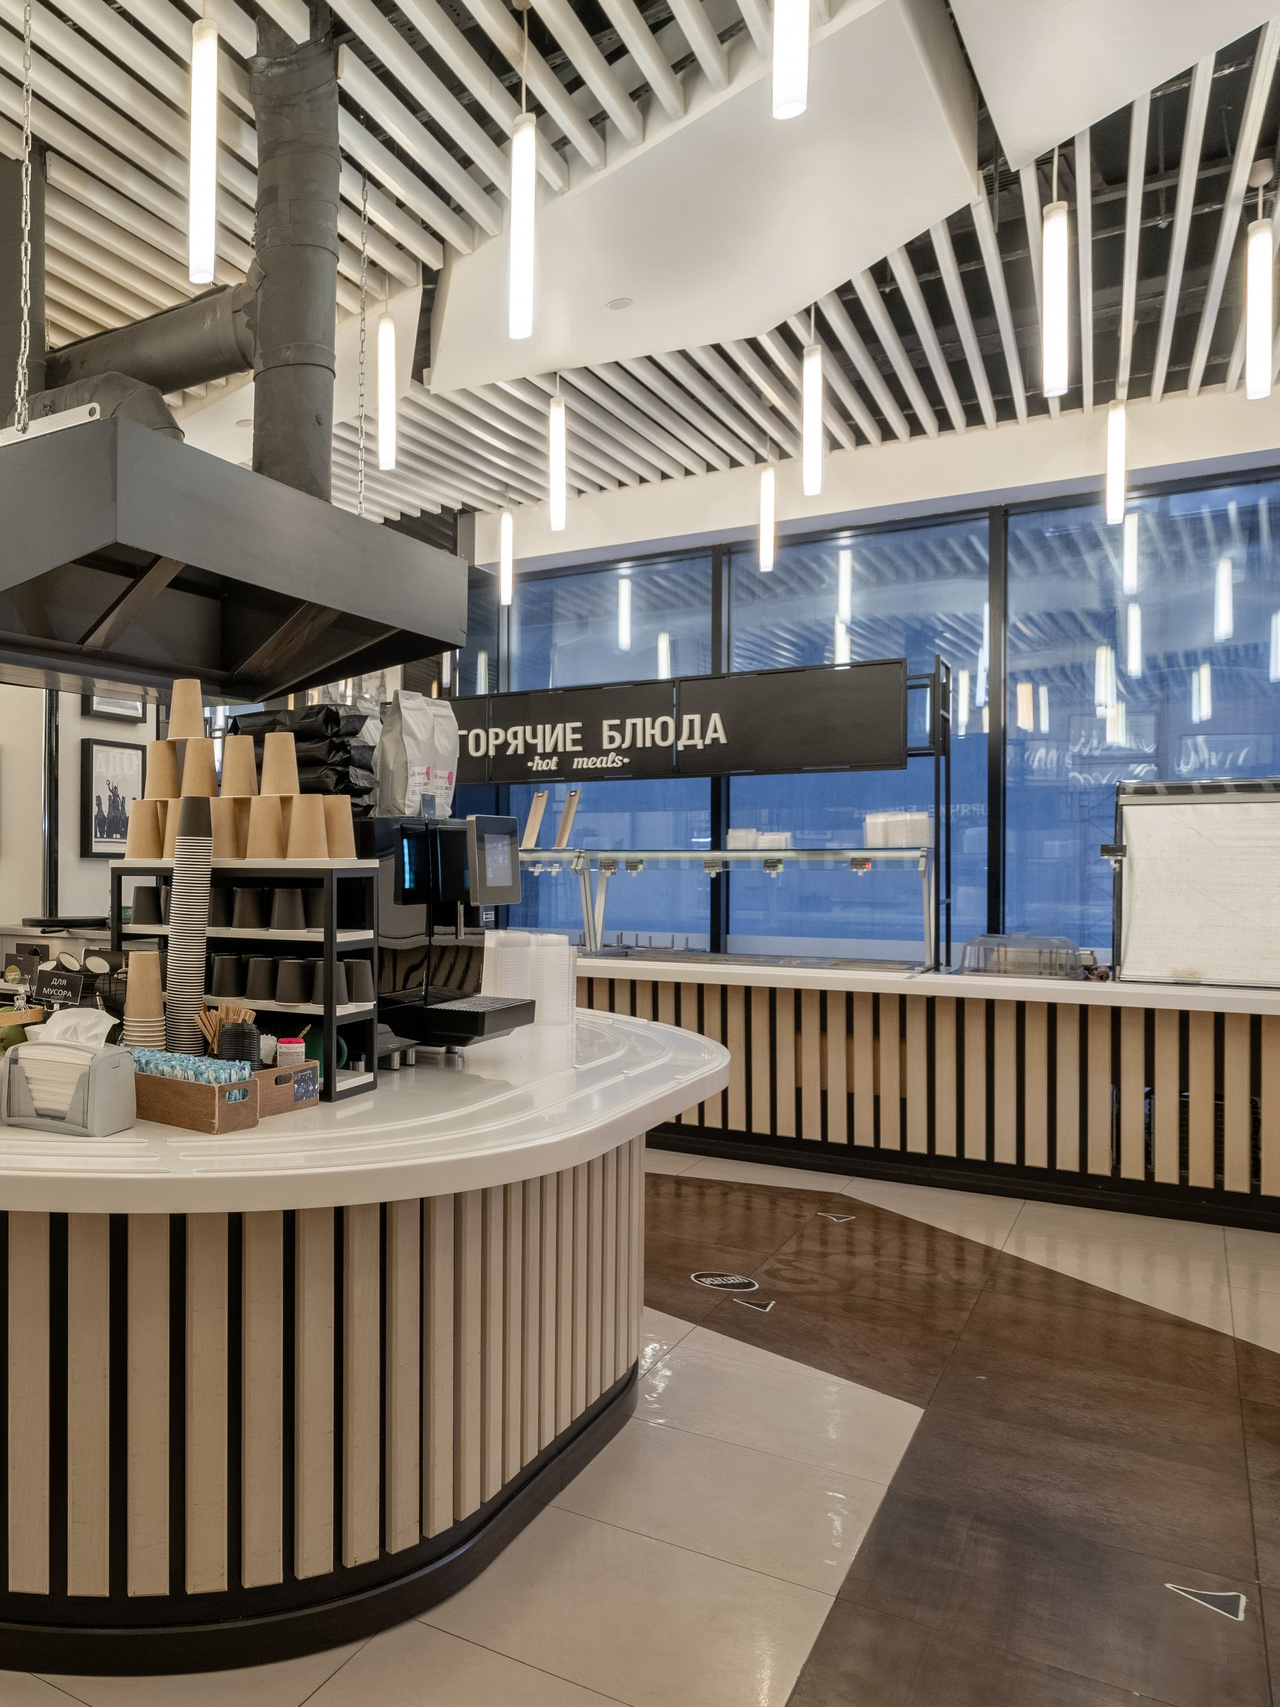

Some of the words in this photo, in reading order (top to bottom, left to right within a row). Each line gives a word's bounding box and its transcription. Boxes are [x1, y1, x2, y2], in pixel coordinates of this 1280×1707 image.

[457, 722, 583, 757] ОРЯЧИЕ
[602, 713, 728, 750] БЛЮДА
[532, 755, 558, 771] hot
[572, 752, 623, 769] meals
[51, 977, 67, 986] ДЛЯ
[42, 987, 72, 998] МУСОРА
